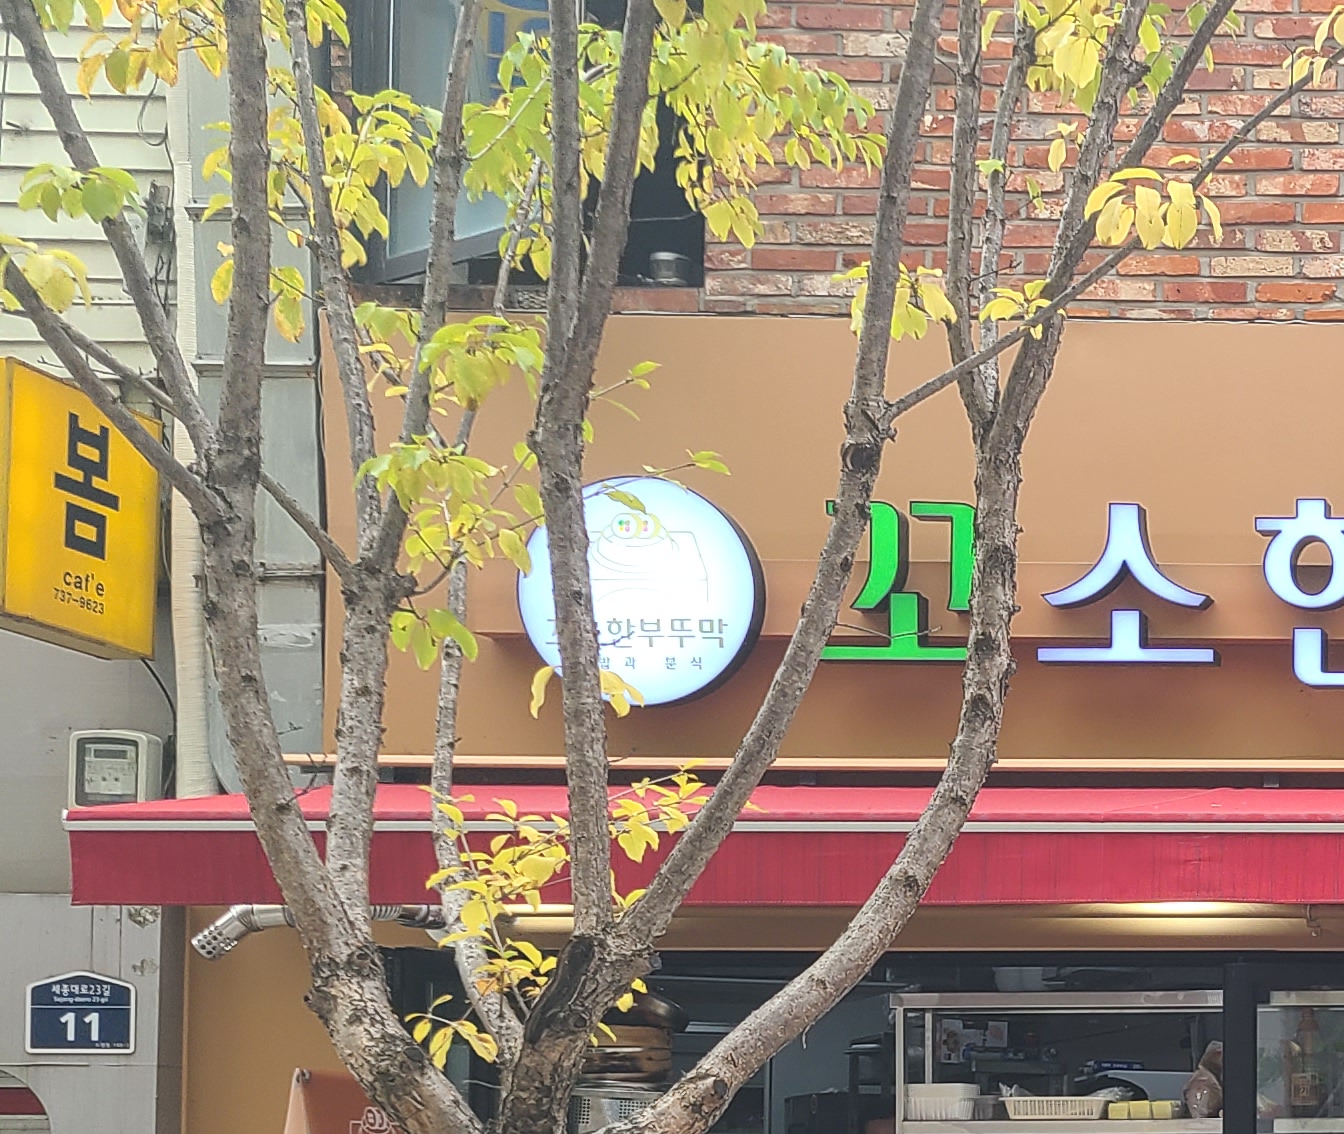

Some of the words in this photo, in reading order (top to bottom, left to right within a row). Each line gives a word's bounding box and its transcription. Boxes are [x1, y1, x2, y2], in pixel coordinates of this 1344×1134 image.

[54, 412, 120, 561] 봄
[53, 587, 105, 615] 737-9623
[51, 984, 111, 997] 세종대로23길
[59, 1012, 99, 1042] 11
